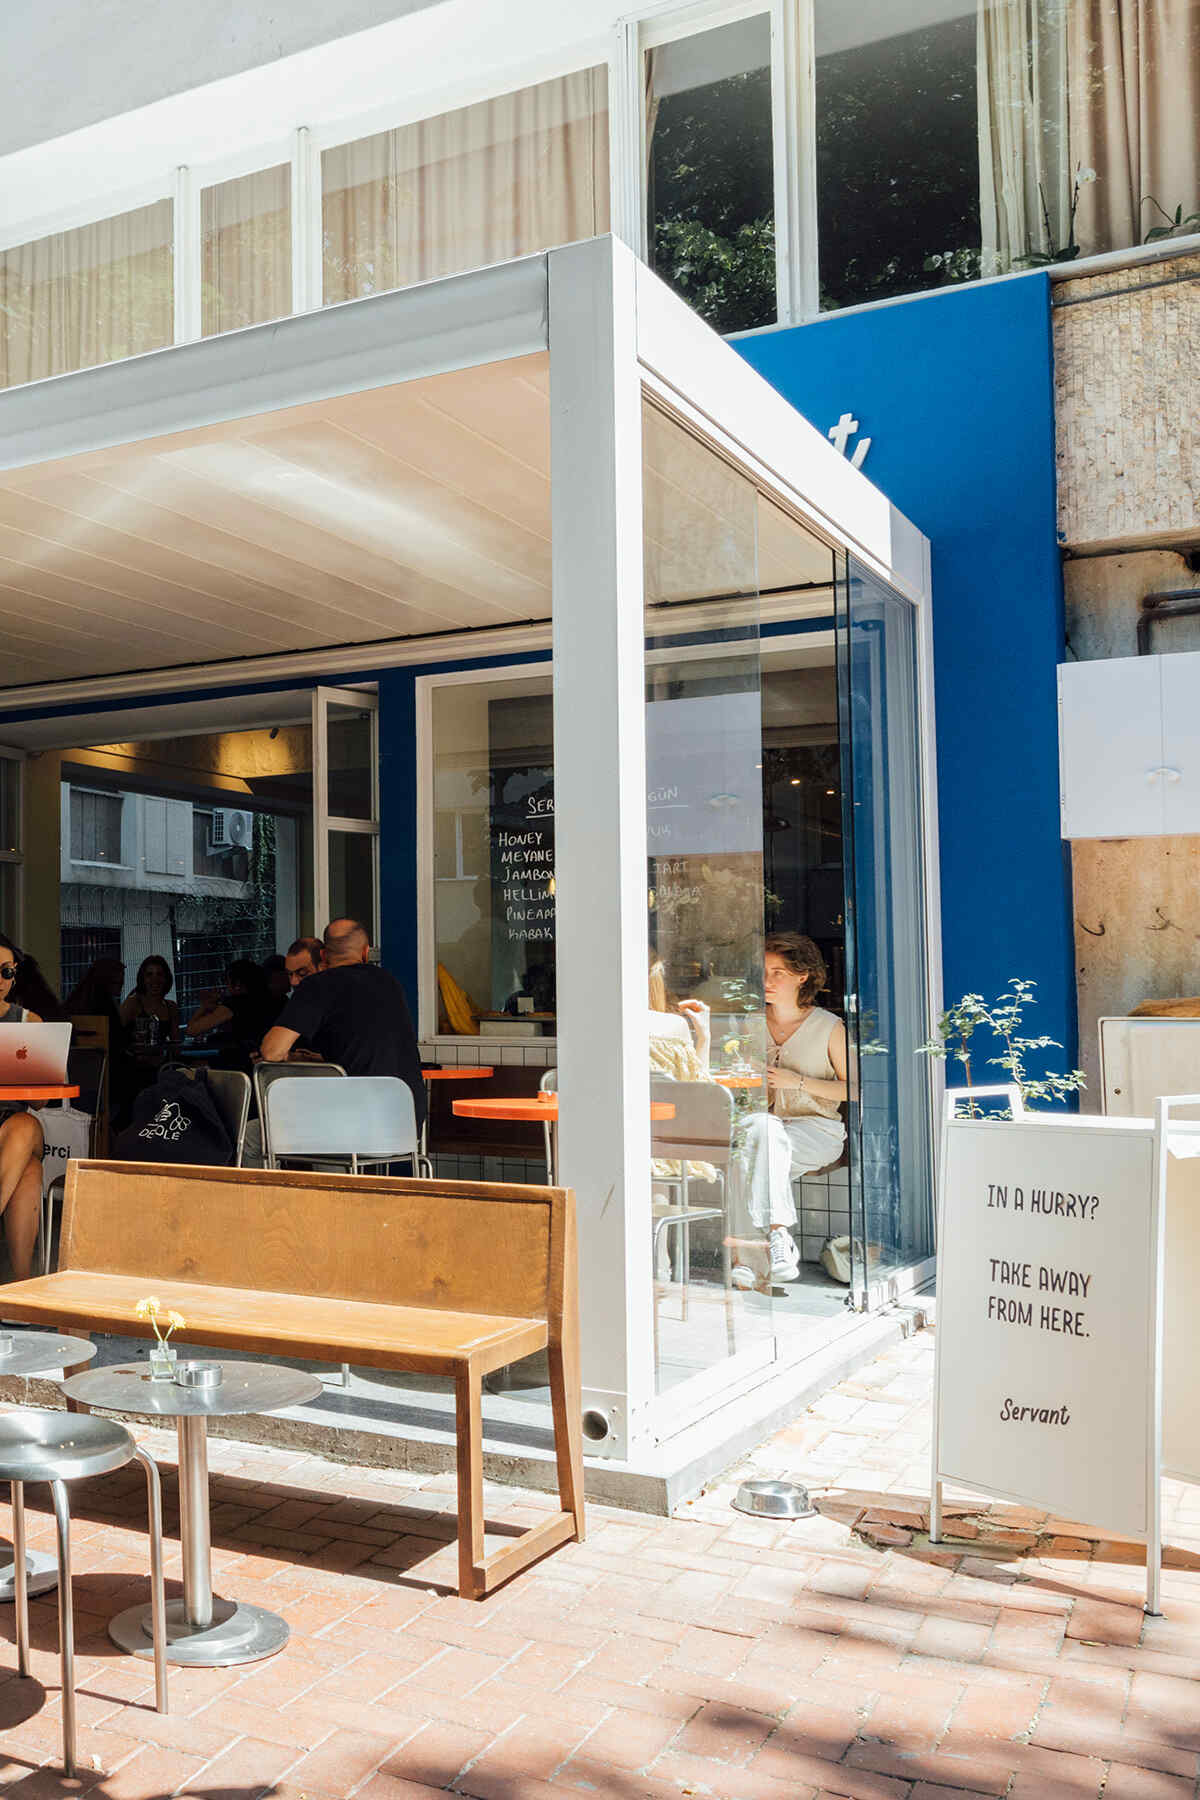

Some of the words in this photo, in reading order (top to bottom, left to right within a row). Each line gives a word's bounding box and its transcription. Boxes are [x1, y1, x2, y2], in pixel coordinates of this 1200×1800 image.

[498, 831, 543, 847] HONEY
[987, 1184, 1008, 1209] IN
[1014, 1187, 1024, 1211] A
[1031, 1188, 1100, 1221] HURRY?
[989, 1258, 1031, 1288] TAKE
[1039, 1266, 1091, 1298] AWAY
[988, 1295, 1033, 1327] FROM
[1040, 1304, 1090, 1337] HERE.
[999, 1397, 1071, 1426] Servant
